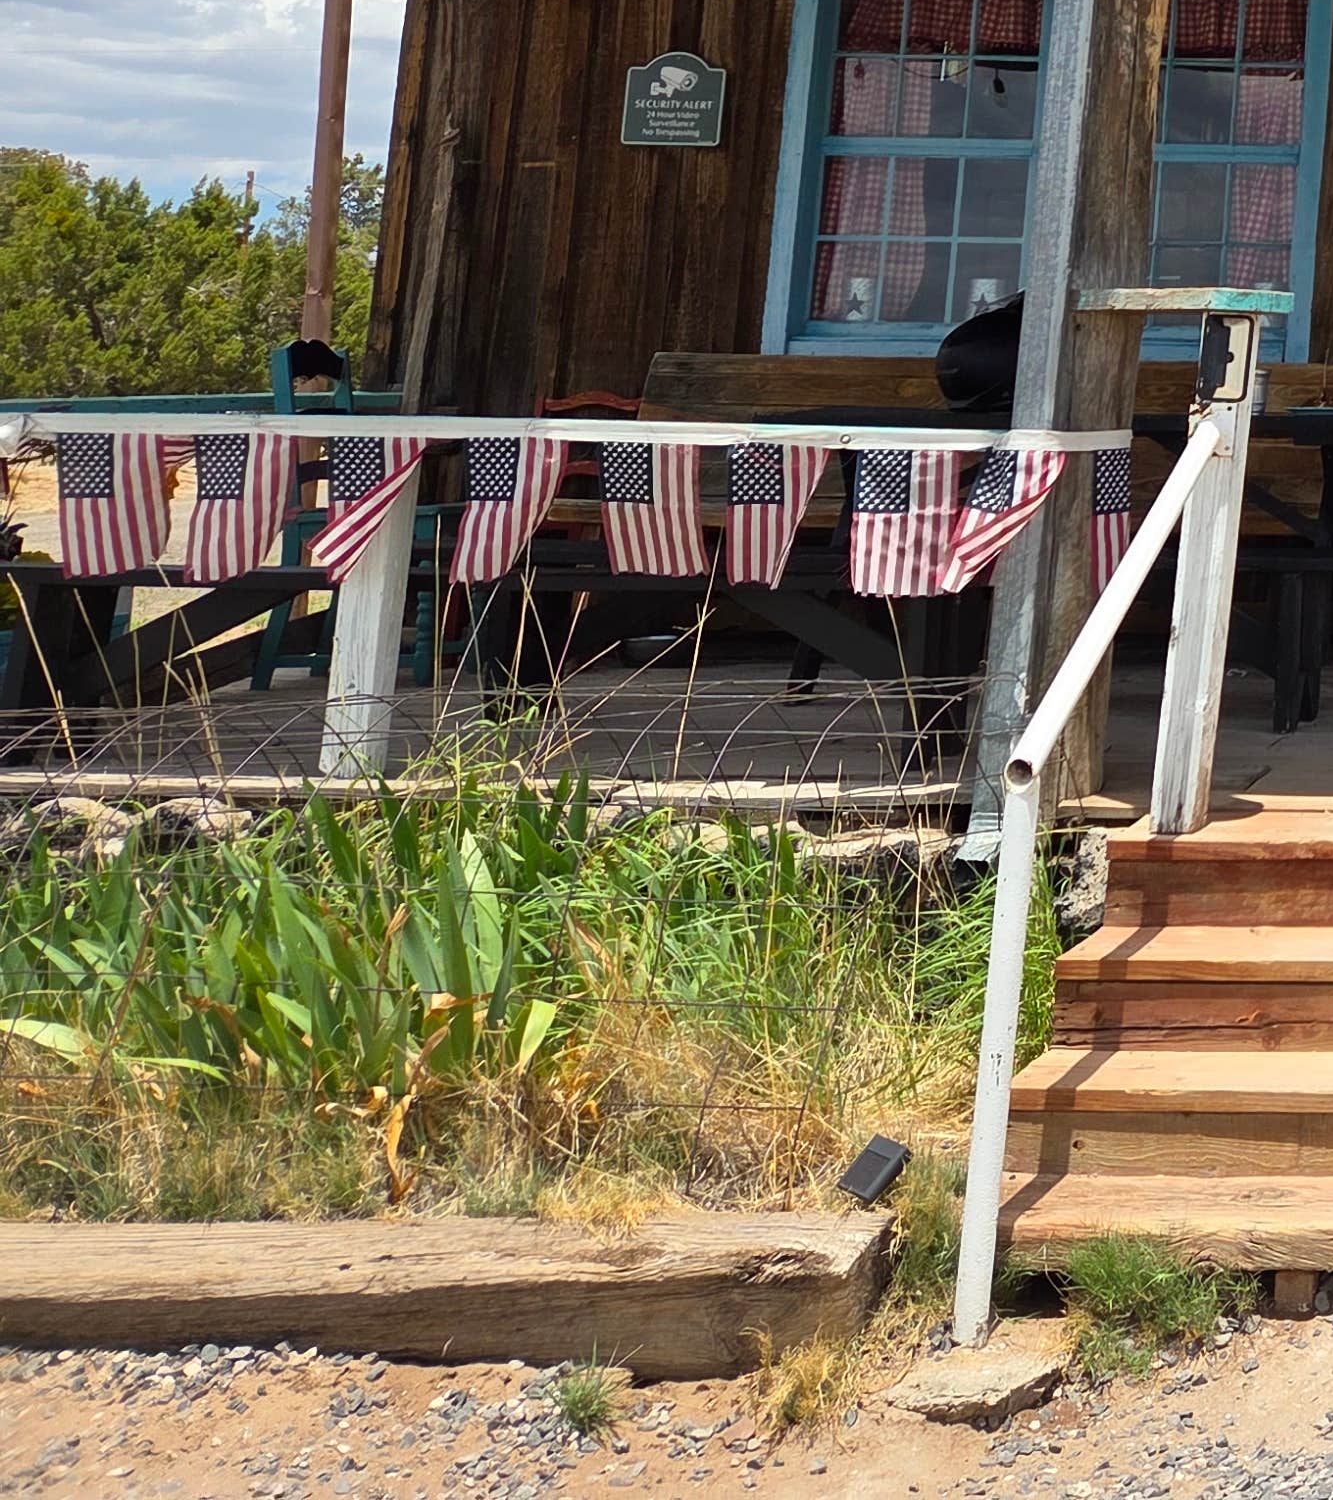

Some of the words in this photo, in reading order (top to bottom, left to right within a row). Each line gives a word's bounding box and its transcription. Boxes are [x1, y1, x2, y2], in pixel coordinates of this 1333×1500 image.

[635, 99, 681, 109] SECURITY
[682, 100, 712, 110] ALERT
[646, 110, 655, 118] 24
[677, 111, 700, 119] Video
[649, 119, 695, 127] Surveillance
[642, 128, 654, 136] No
[655, 128, 700, 138] Trespassing
